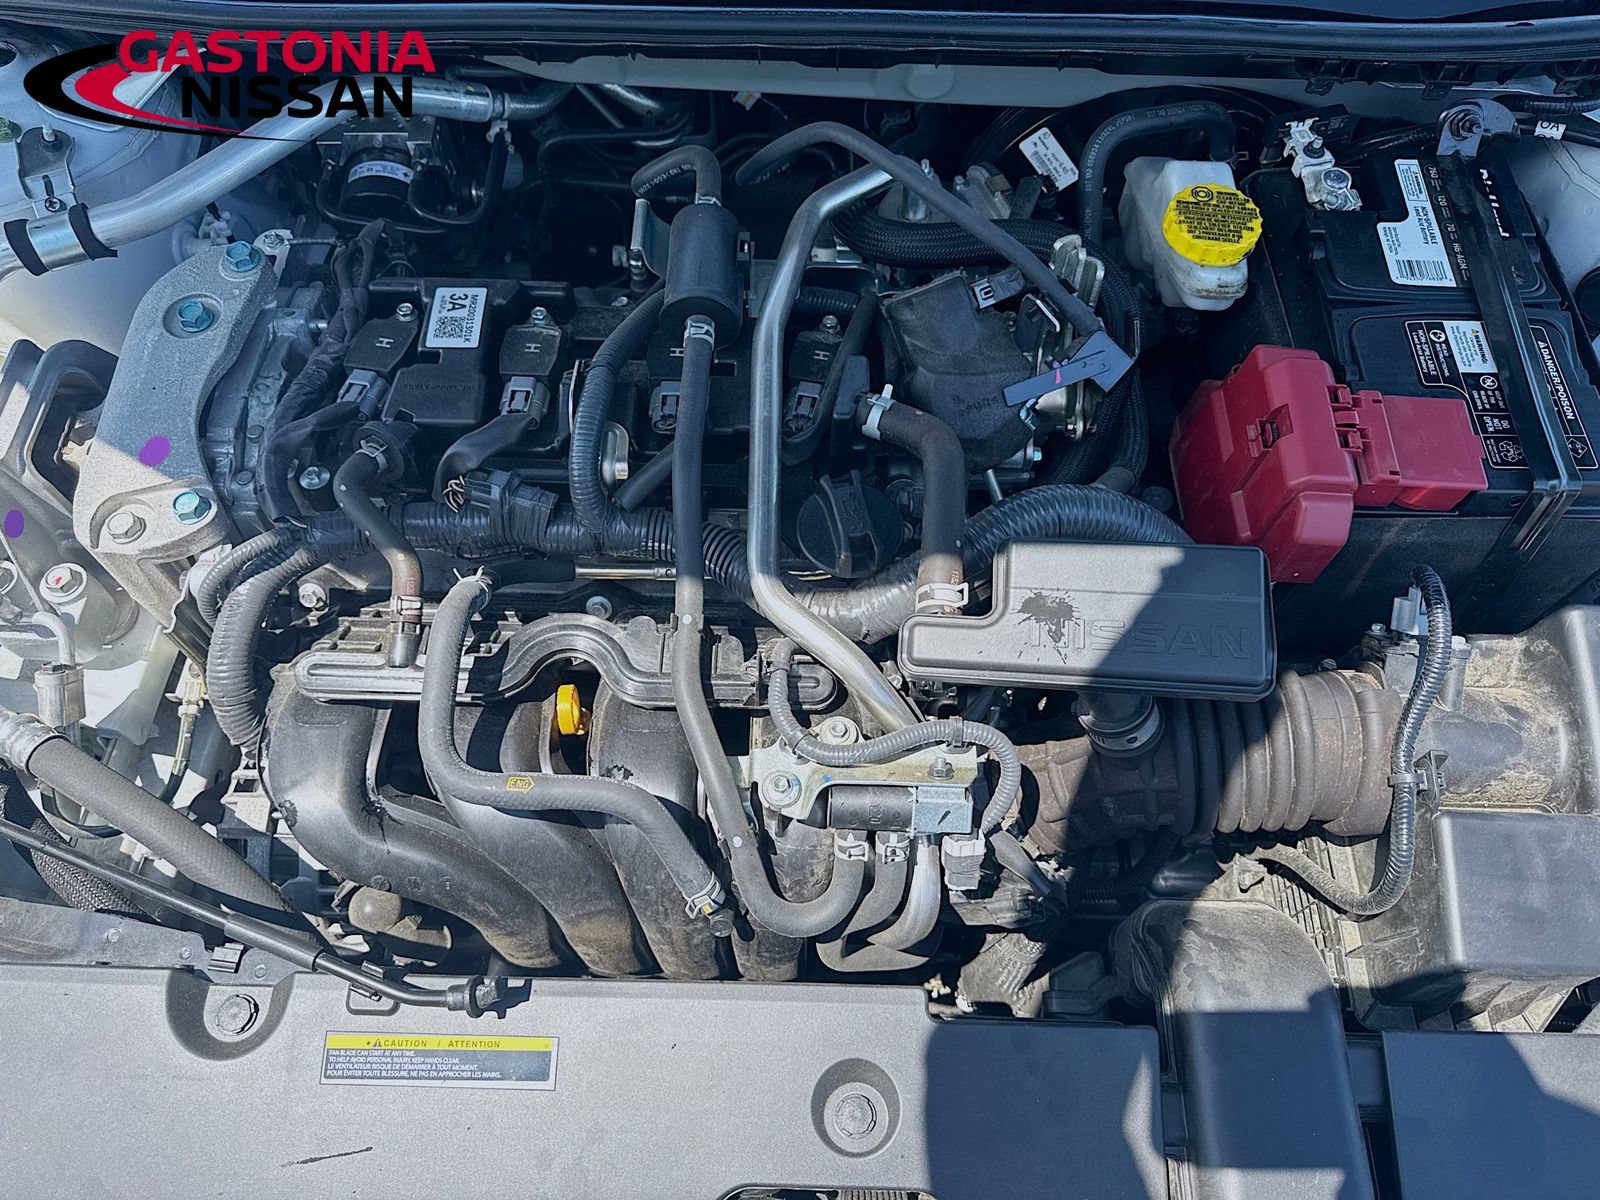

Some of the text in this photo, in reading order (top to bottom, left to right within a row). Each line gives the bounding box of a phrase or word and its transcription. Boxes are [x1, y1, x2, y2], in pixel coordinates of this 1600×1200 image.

[448, 293, 469, 312] 3A
[524, 343, 541, 353] H
[1418, 330, 1437, 375] NON-SPILLABLE
[812, 350, 830, 361] H
[1542, 351, 1575, 420] DANGER/POISON
[1493, 418, 1502, 430] NOT
[1502, 420, 1510, 428] DO
[1032, 618, 1250, 659] NISSAN
[510, 779, 530, 789] ENG
[383, 1039, 427, 1047] CAUTION
[448, 1040, 500, 1048] ATTENTION
